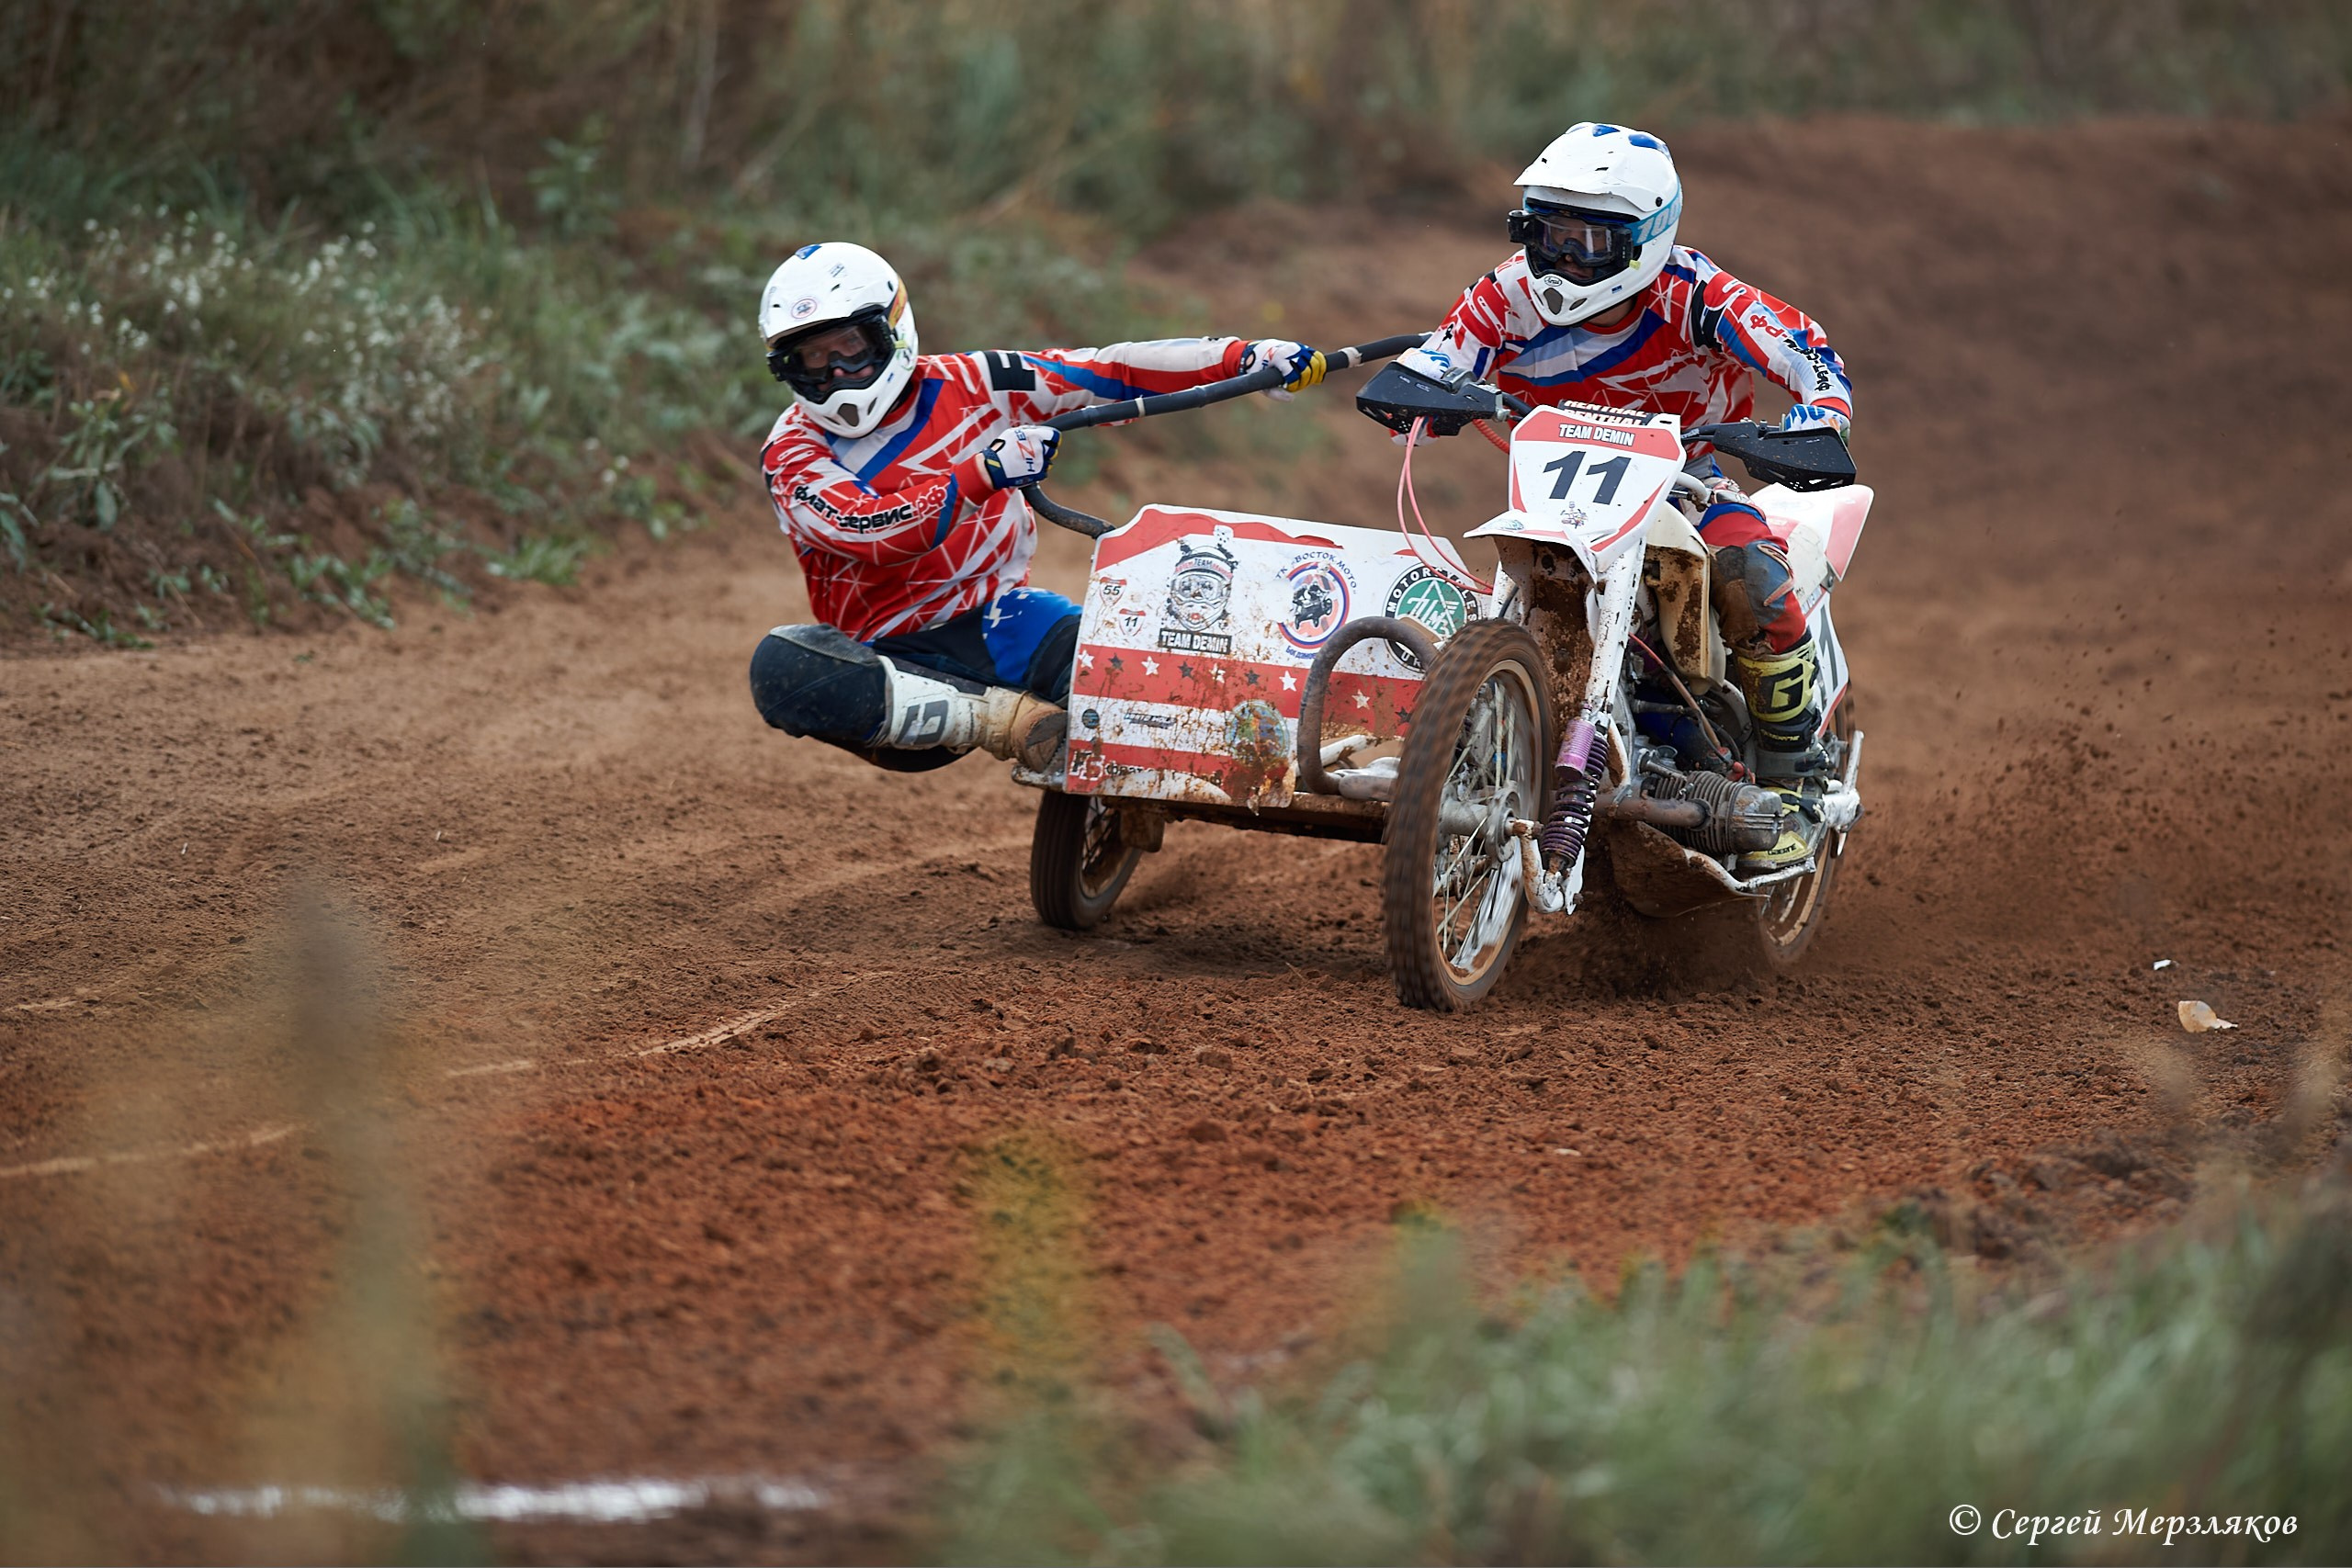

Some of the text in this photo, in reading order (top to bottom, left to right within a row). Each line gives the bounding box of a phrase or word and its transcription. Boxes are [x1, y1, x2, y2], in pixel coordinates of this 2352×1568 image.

[1564, 400, 1648, 417] RENTHAL
[1559, 423, 1635, 446] TEAM DEMIN
[1542, 450, 1632, 505] 11
[1102, 584, 1122, 596] 55
[1124, 616, 1139, 628] 11
[1160, 631, 1229, 653] TEAM DEMIN
